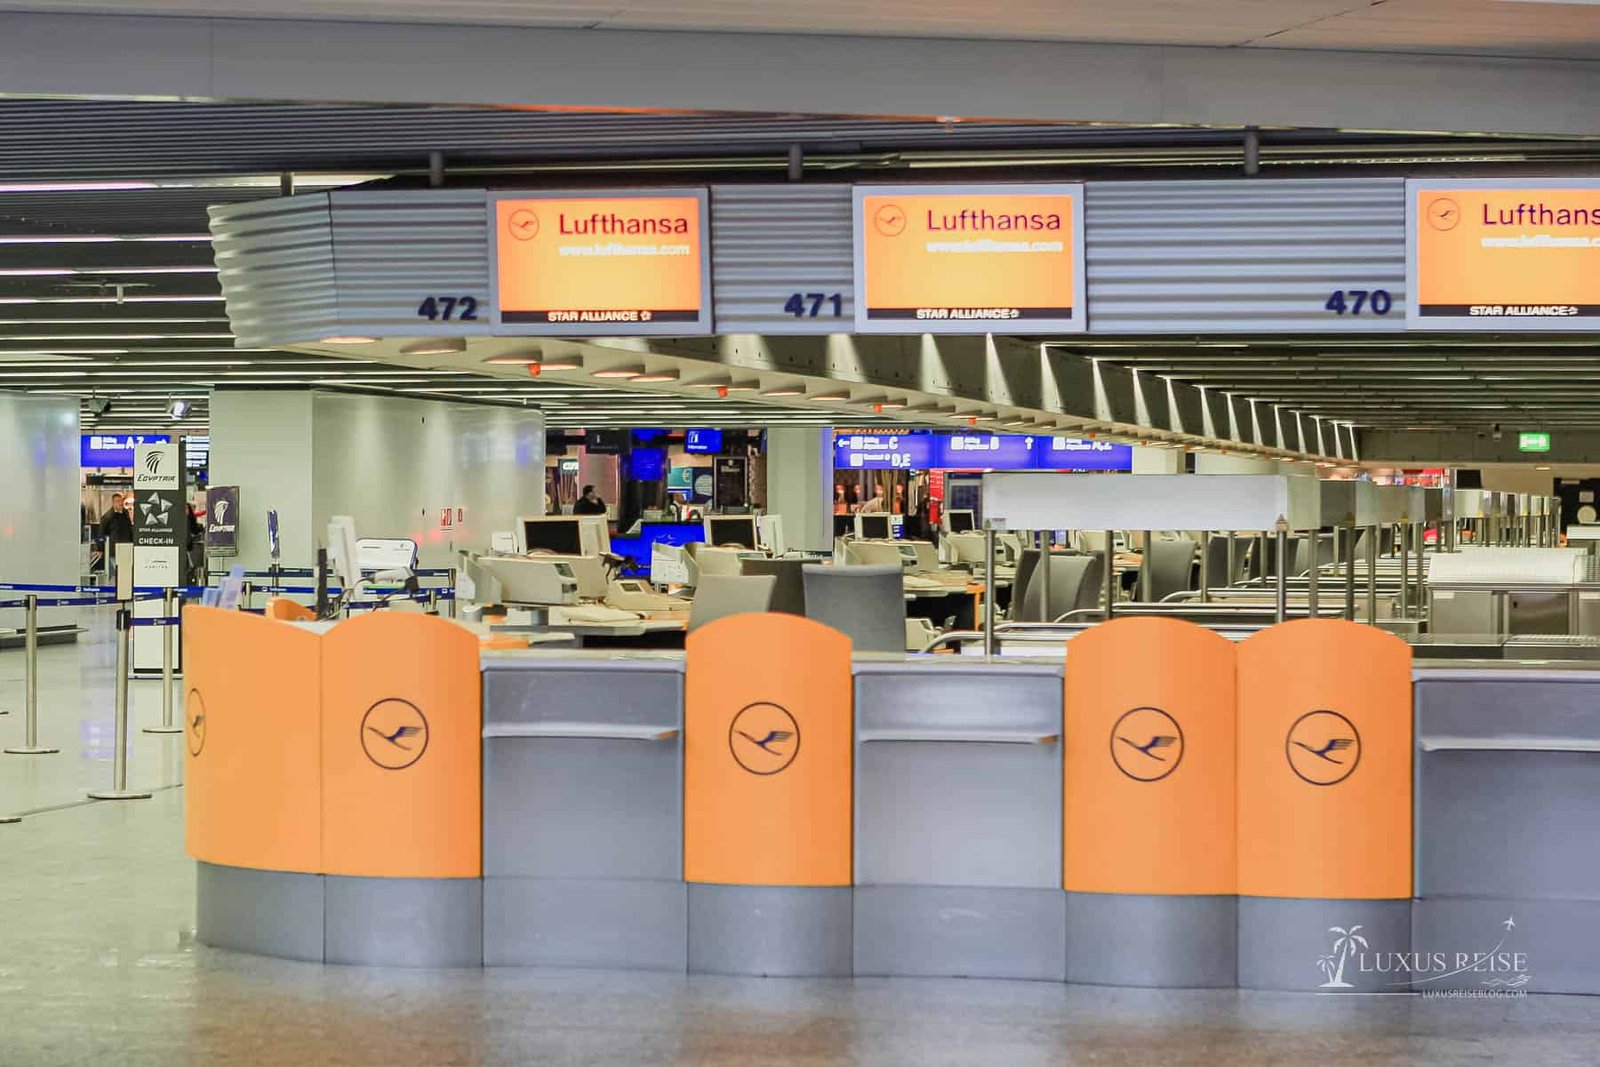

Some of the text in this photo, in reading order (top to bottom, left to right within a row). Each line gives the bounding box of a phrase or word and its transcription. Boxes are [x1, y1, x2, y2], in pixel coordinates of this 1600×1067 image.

[559, 213, 688, 236] Lufthansa
[927, 209, 1061, 231] Lufthansa
[418, 296, 478, 321] 472
[784, 293, 843, 318] 471
[1325, 289, 1392, 315] 470
[1469, 305, 1568, 316] STAR ALLIANCE
[547, 311, 638, 321] STAR ALLIANCE
[916, 308, 1011, 319] STAR ALLIANCE
[138, 537, 174, 545] CHECK-IN
